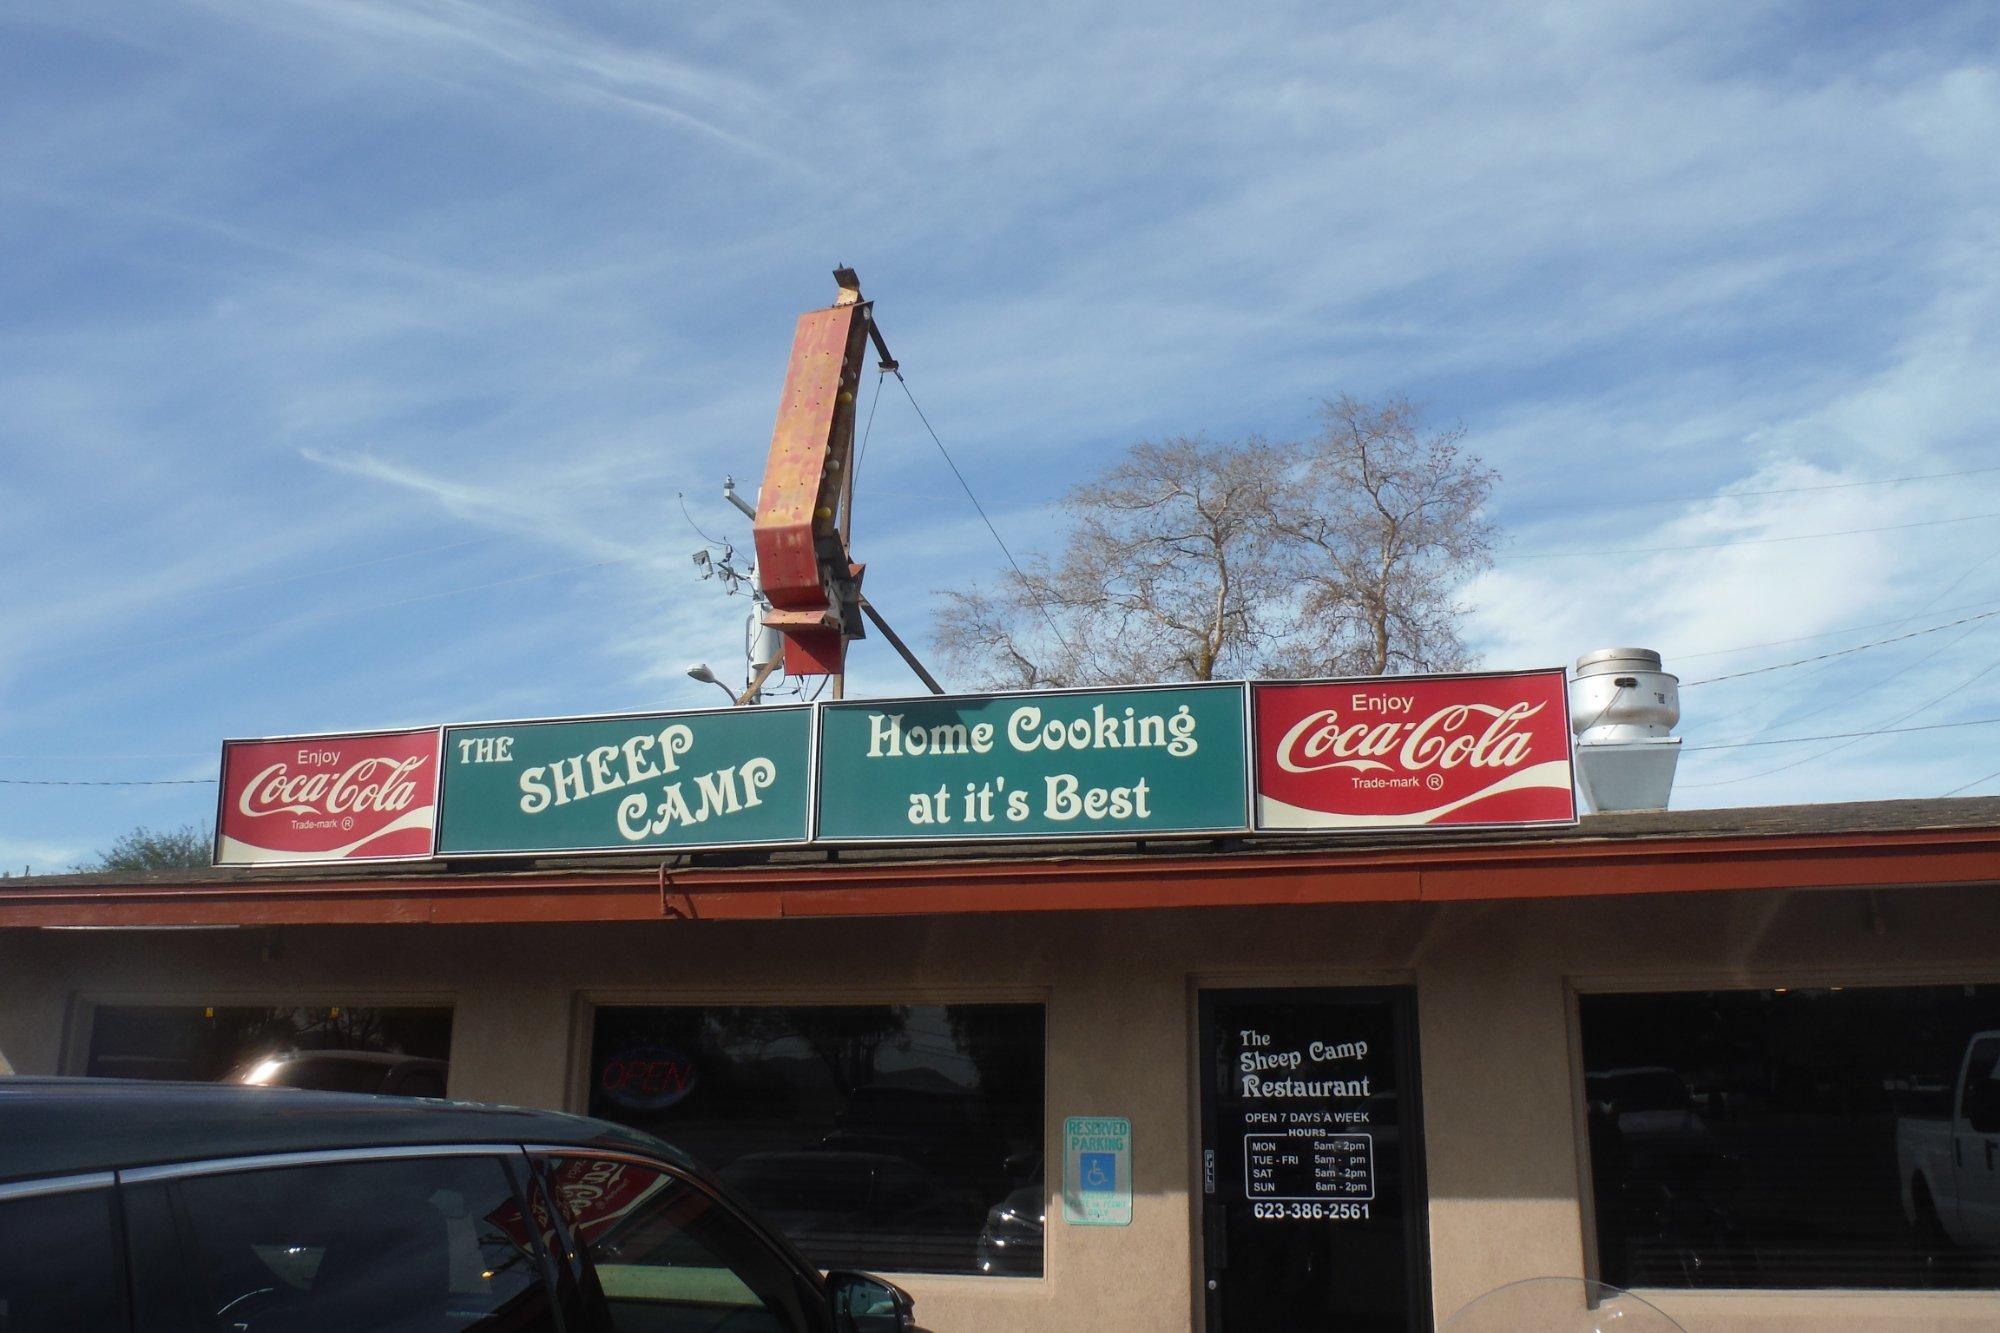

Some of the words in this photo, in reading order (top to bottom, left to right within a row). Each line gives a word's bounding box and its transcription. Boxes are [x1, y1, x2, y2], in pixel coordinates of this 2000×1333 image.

[1351, 693, 1414, 714] Enjoy
[866, 713, 994, 757] Home
[1007, 704, 1198, 757] Cooking
[1276, 700, 1547, 773] Coca-Cola
[297, 749, 341, 767] Enjoy
[458, 736, 515, 764] THE
[519, 724, 694, 814] SHEEP
[238, 754, 429, 818] Coca-Cola
[1351, 776, 1420, 789] Trade-mark
[617, 757, 776, 841] CAMP
[907, 783, 951, 824] at
[963, 776, 1030, 823] it's
[1043, 773, 1151, 821] Best
[291, 819, 338, 830] Trade-mark
[1240, 1030, 1271, 1046] The
[1240, 1051, 1301, 1072] Sheep
[1309, 1041, 1368, 1062] Camp
[602, 1058, 697, 1094] OPEN
[1242, 1074, 1371, 1098] Restaurant
[1245, 1113, 1277, 1123] OPEN
[1280, 1113, 1286, 1122] 7
[1290, 1113, 1320, 1123] DAYS
[1323, 1113, 1331, 1122] A
[1334, 1112, 1370, 1123] WEEK
[1068, 1120, 1127, 1136] RESERVED
[1288, 1128, 1327, 1137] HOURS
[1071, 1137, 1123, 1151] PARKING
[1252, 1142, 1276, 1151] MON
[1313, 1141, 1335, 1151] 5am
[1343, 1141, 1365, 1153] 2pm
[1252, 1155, 1273, 1164] TUE
[1281, 1155, 1299, 1165] FRI
[1314, 1154, 1335, 1164] 5am
[1253, 1168, 1273, 1178] SAT
[1315, 1168, 1336, 1178] 5am
[1344, 1168, 1367, 1180] 2pm
[1253, 1182, 1275, 1192] SUN
[1345, 1182, 1367, 1193] 2pm
[1254, 1203, 1370, 1219] 623-386-2561
